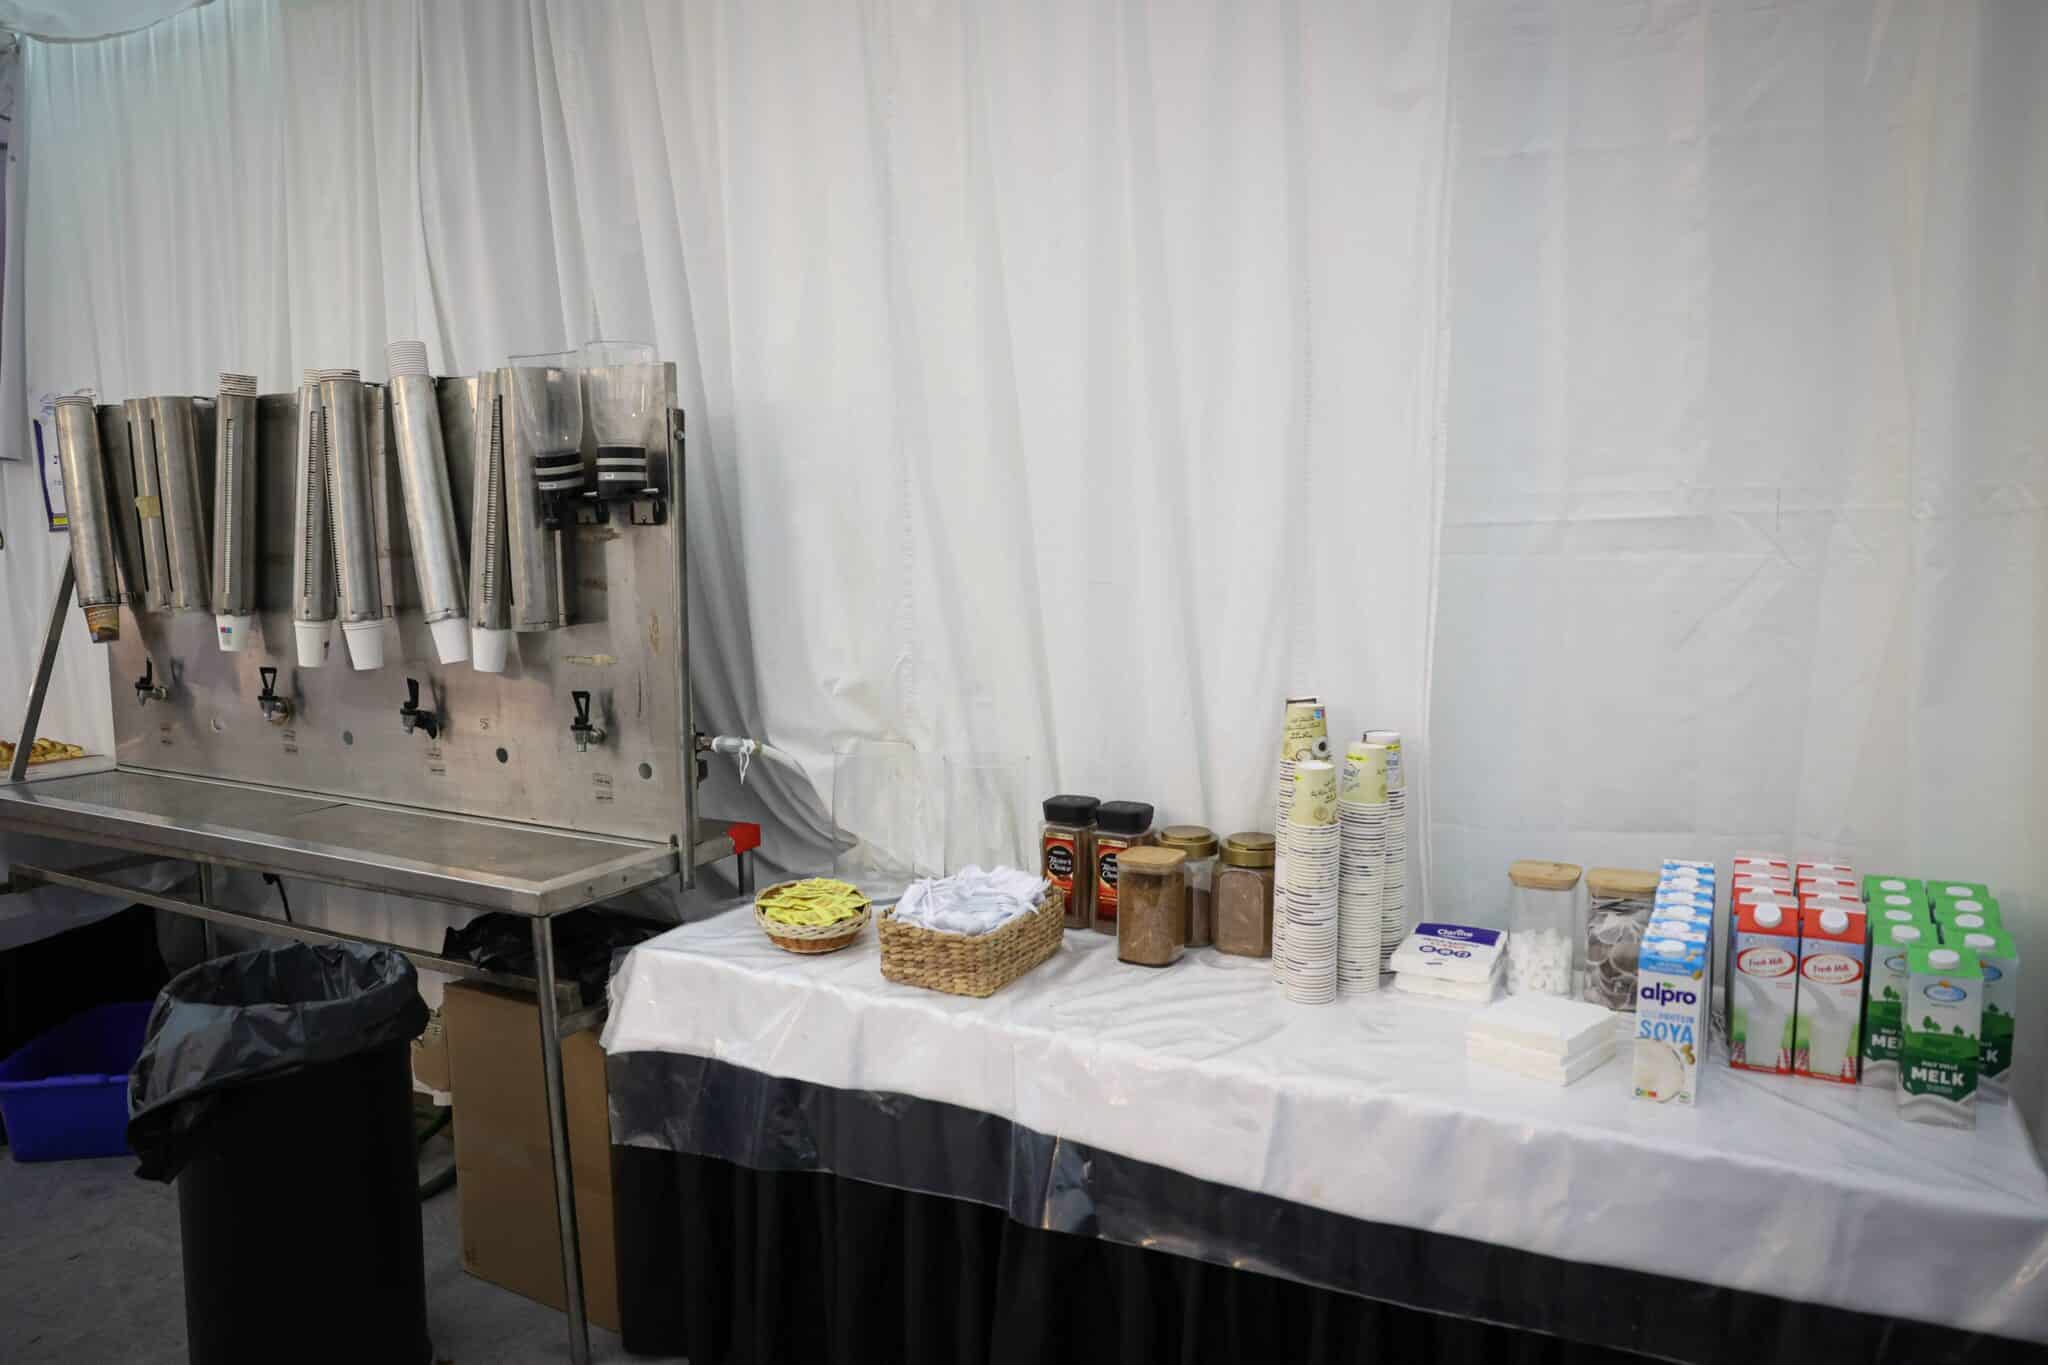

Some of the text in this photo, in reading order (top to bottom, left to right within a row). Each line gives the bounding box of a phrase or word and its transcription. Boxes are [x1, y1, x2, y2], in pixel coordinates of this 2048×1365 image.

[1641, 982, 1697, 1006] alpro
[1640, 1019, 1694, 1045] SOYA
[1871, 1033, 1902, 1049] ME
[1911, 1066, 1965, 1087] MELK
